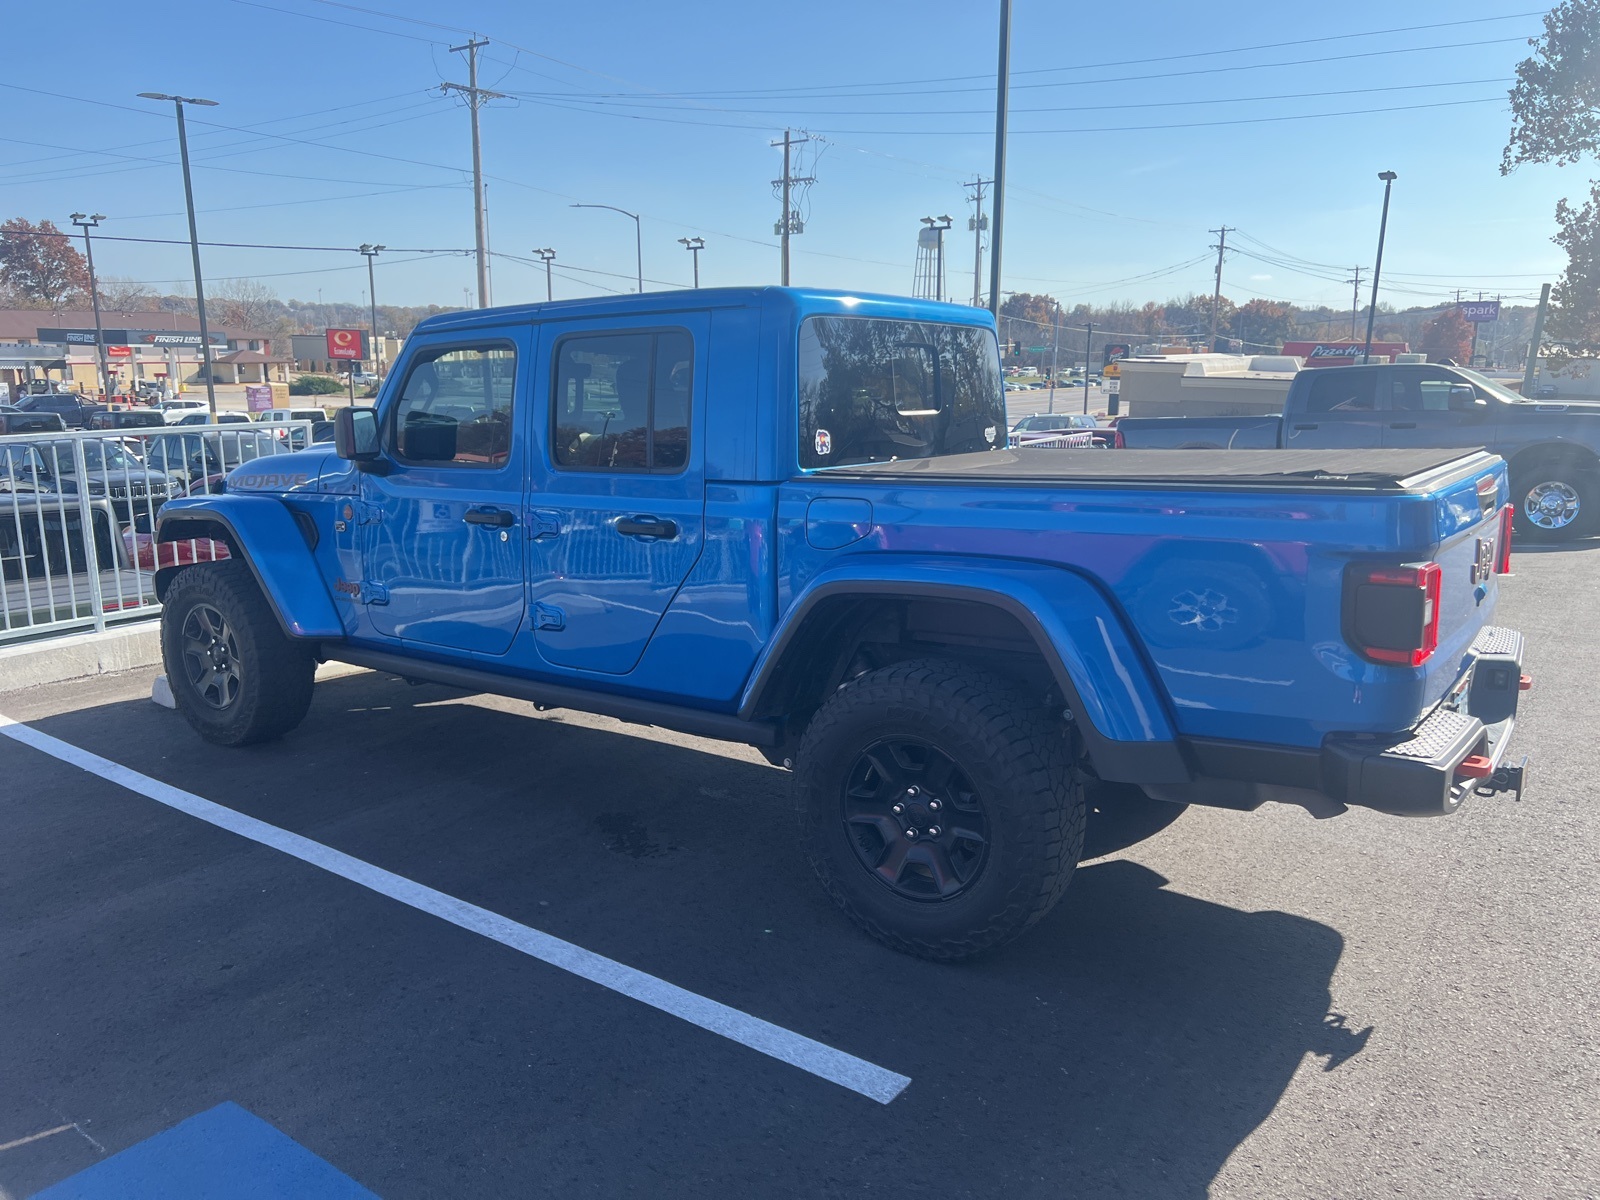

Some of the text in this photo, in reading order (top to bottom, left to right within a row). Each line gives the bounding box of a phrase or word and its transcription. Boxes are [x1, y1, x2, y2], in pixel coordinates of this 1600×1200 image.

[1462, 304, 1496, 317] spark
[67, 333, 95, 342] FINISH LINE
[154, 335, 183, 343] FINISH
[1310, 345, 1343, 356] Pizza
[227, 473, 308, 488] MOJAVE
[333, 577, 360, 597] Jeep
